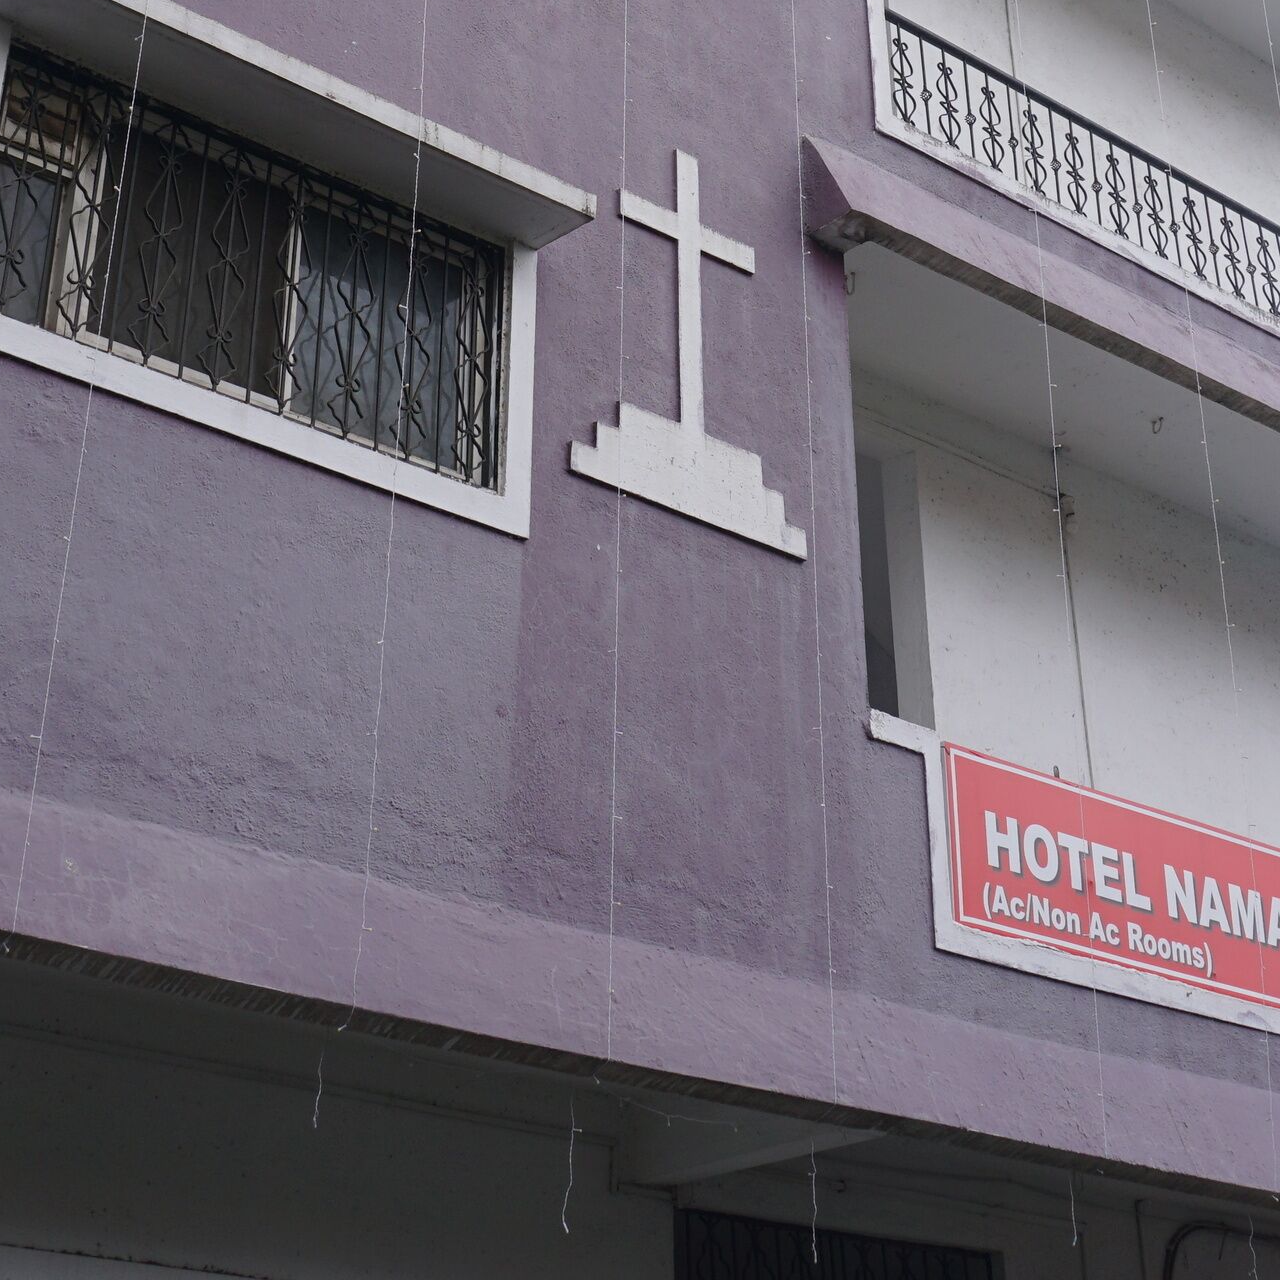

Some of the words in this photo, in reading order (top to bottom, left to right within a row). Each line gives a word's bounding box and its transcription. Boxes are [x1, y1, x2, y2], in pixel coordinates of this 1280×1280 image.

[984, 810, 1153, 911] HOTEL
[982, 882, 1082, 935] (Ac/Non
[1089, 912, 1121, 947] Ac
[1127, 922, 1215, 978] Rooms)
